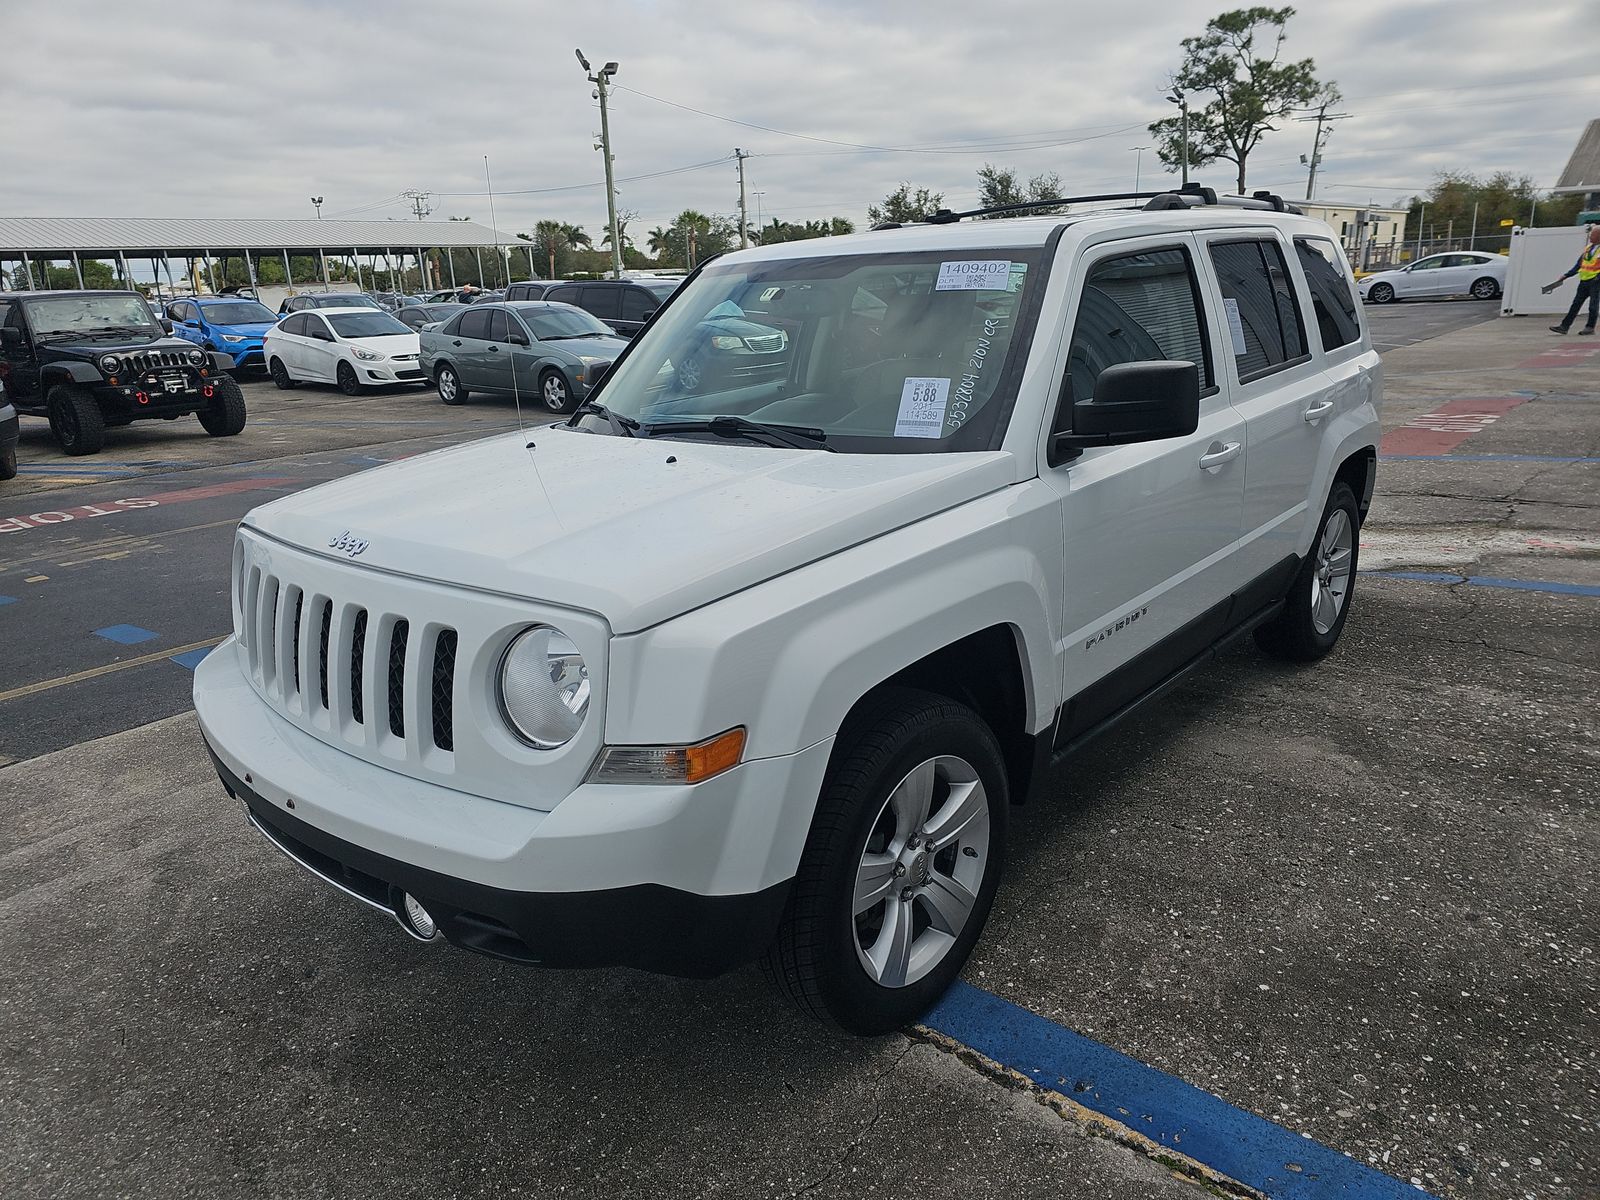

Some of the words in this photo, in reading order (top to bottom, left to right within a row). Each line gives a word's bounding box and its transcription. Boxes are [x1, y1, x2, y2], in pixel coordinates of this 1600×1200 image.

[946, 263, 1007, 274] 1409402
[913, 388, 937, 402] 5:88
[947, 373, 980, 428] 5532804
[0, 498, 159, 533] STOP
[328, 530, 369, 558] Jeep
[1085, 604, 1151, 650] PATRIOT
